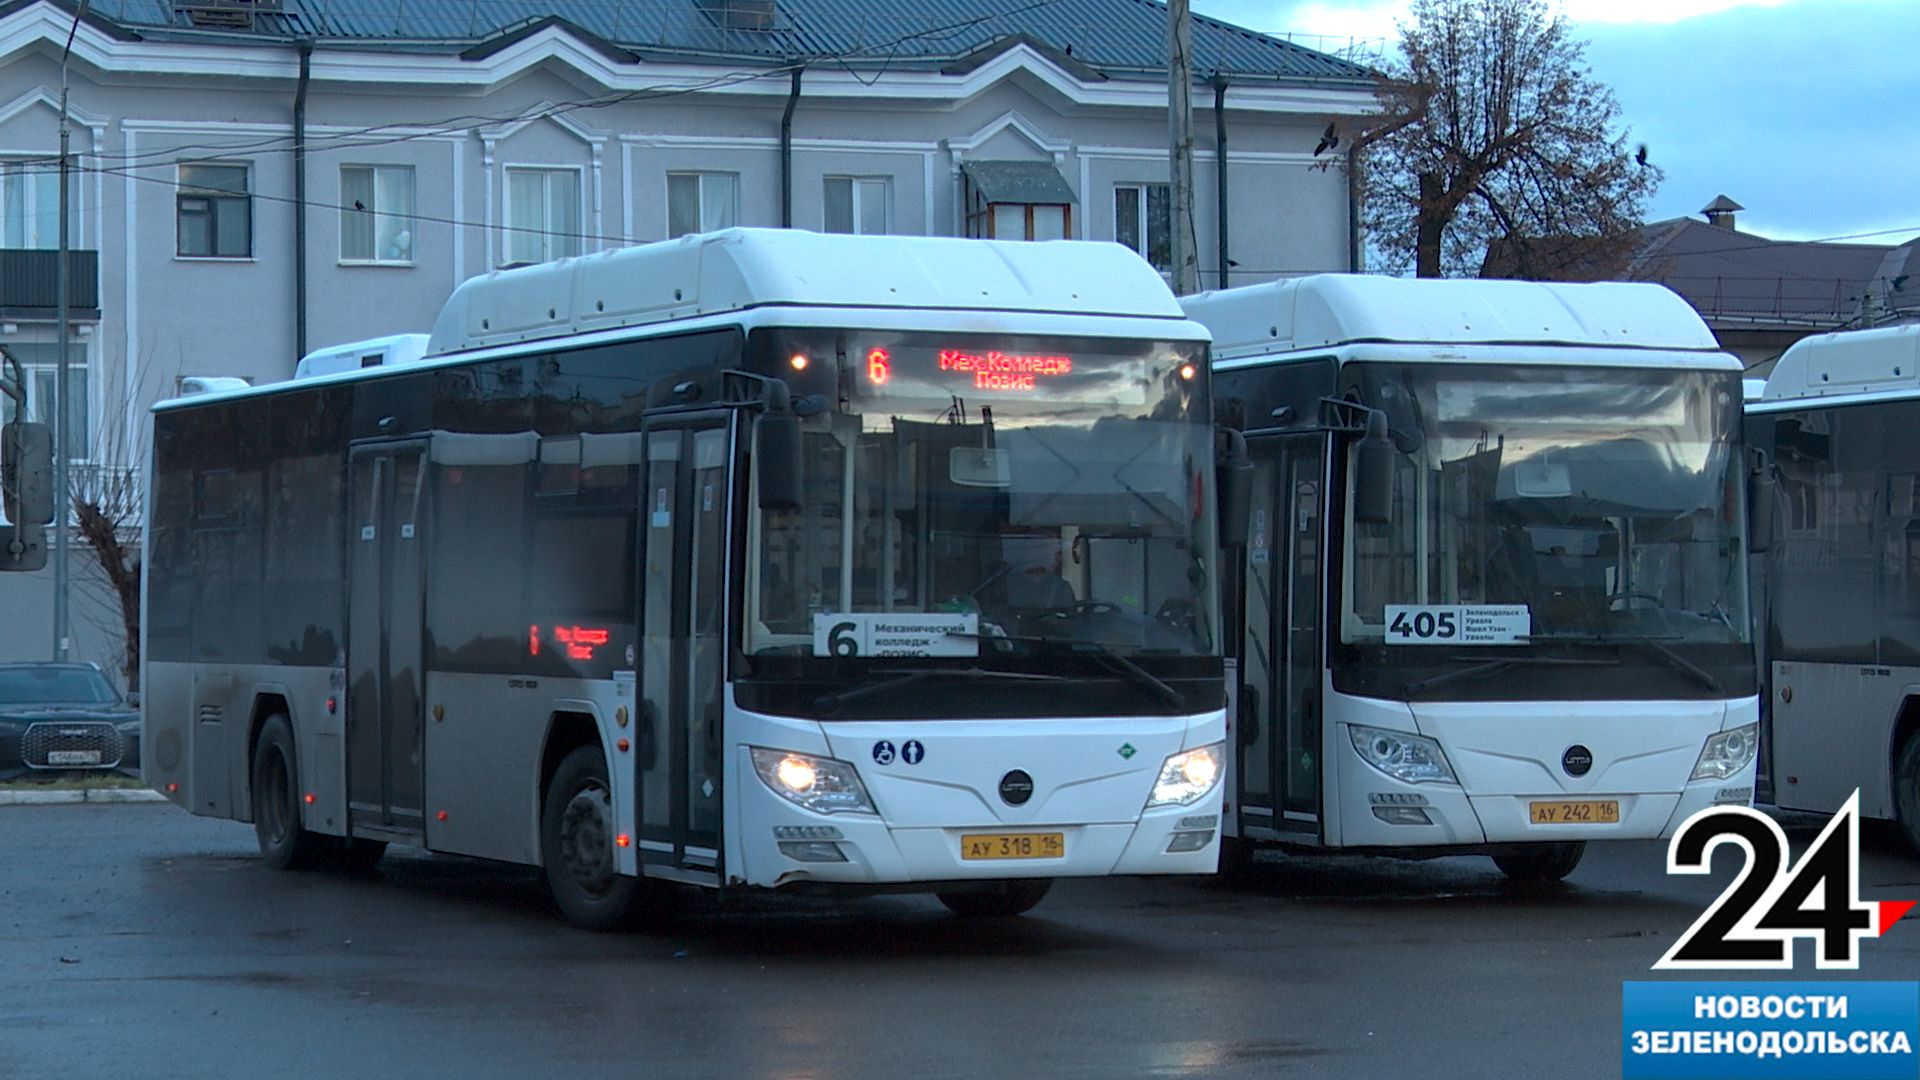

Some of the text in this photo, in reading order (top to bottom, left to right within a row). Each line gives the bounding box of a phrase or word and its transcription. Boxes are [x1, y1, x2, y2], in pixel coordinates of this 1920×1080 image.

[868, 349, 889, 385] 6
[975, 371, 1036, 390] Позис
[875, 623, 966, 633] Механический
[1390, 612, 1456, 638] 405
[828, 622, 858, 657] 6
[875, 638, 930, 647] колледж
[1563, 804, 1591, 820] 242
[1599, 803, 1614, 815] 16
[1000, 837, 1032, 855] 318
[1041, 836, 1058, 849] 16
